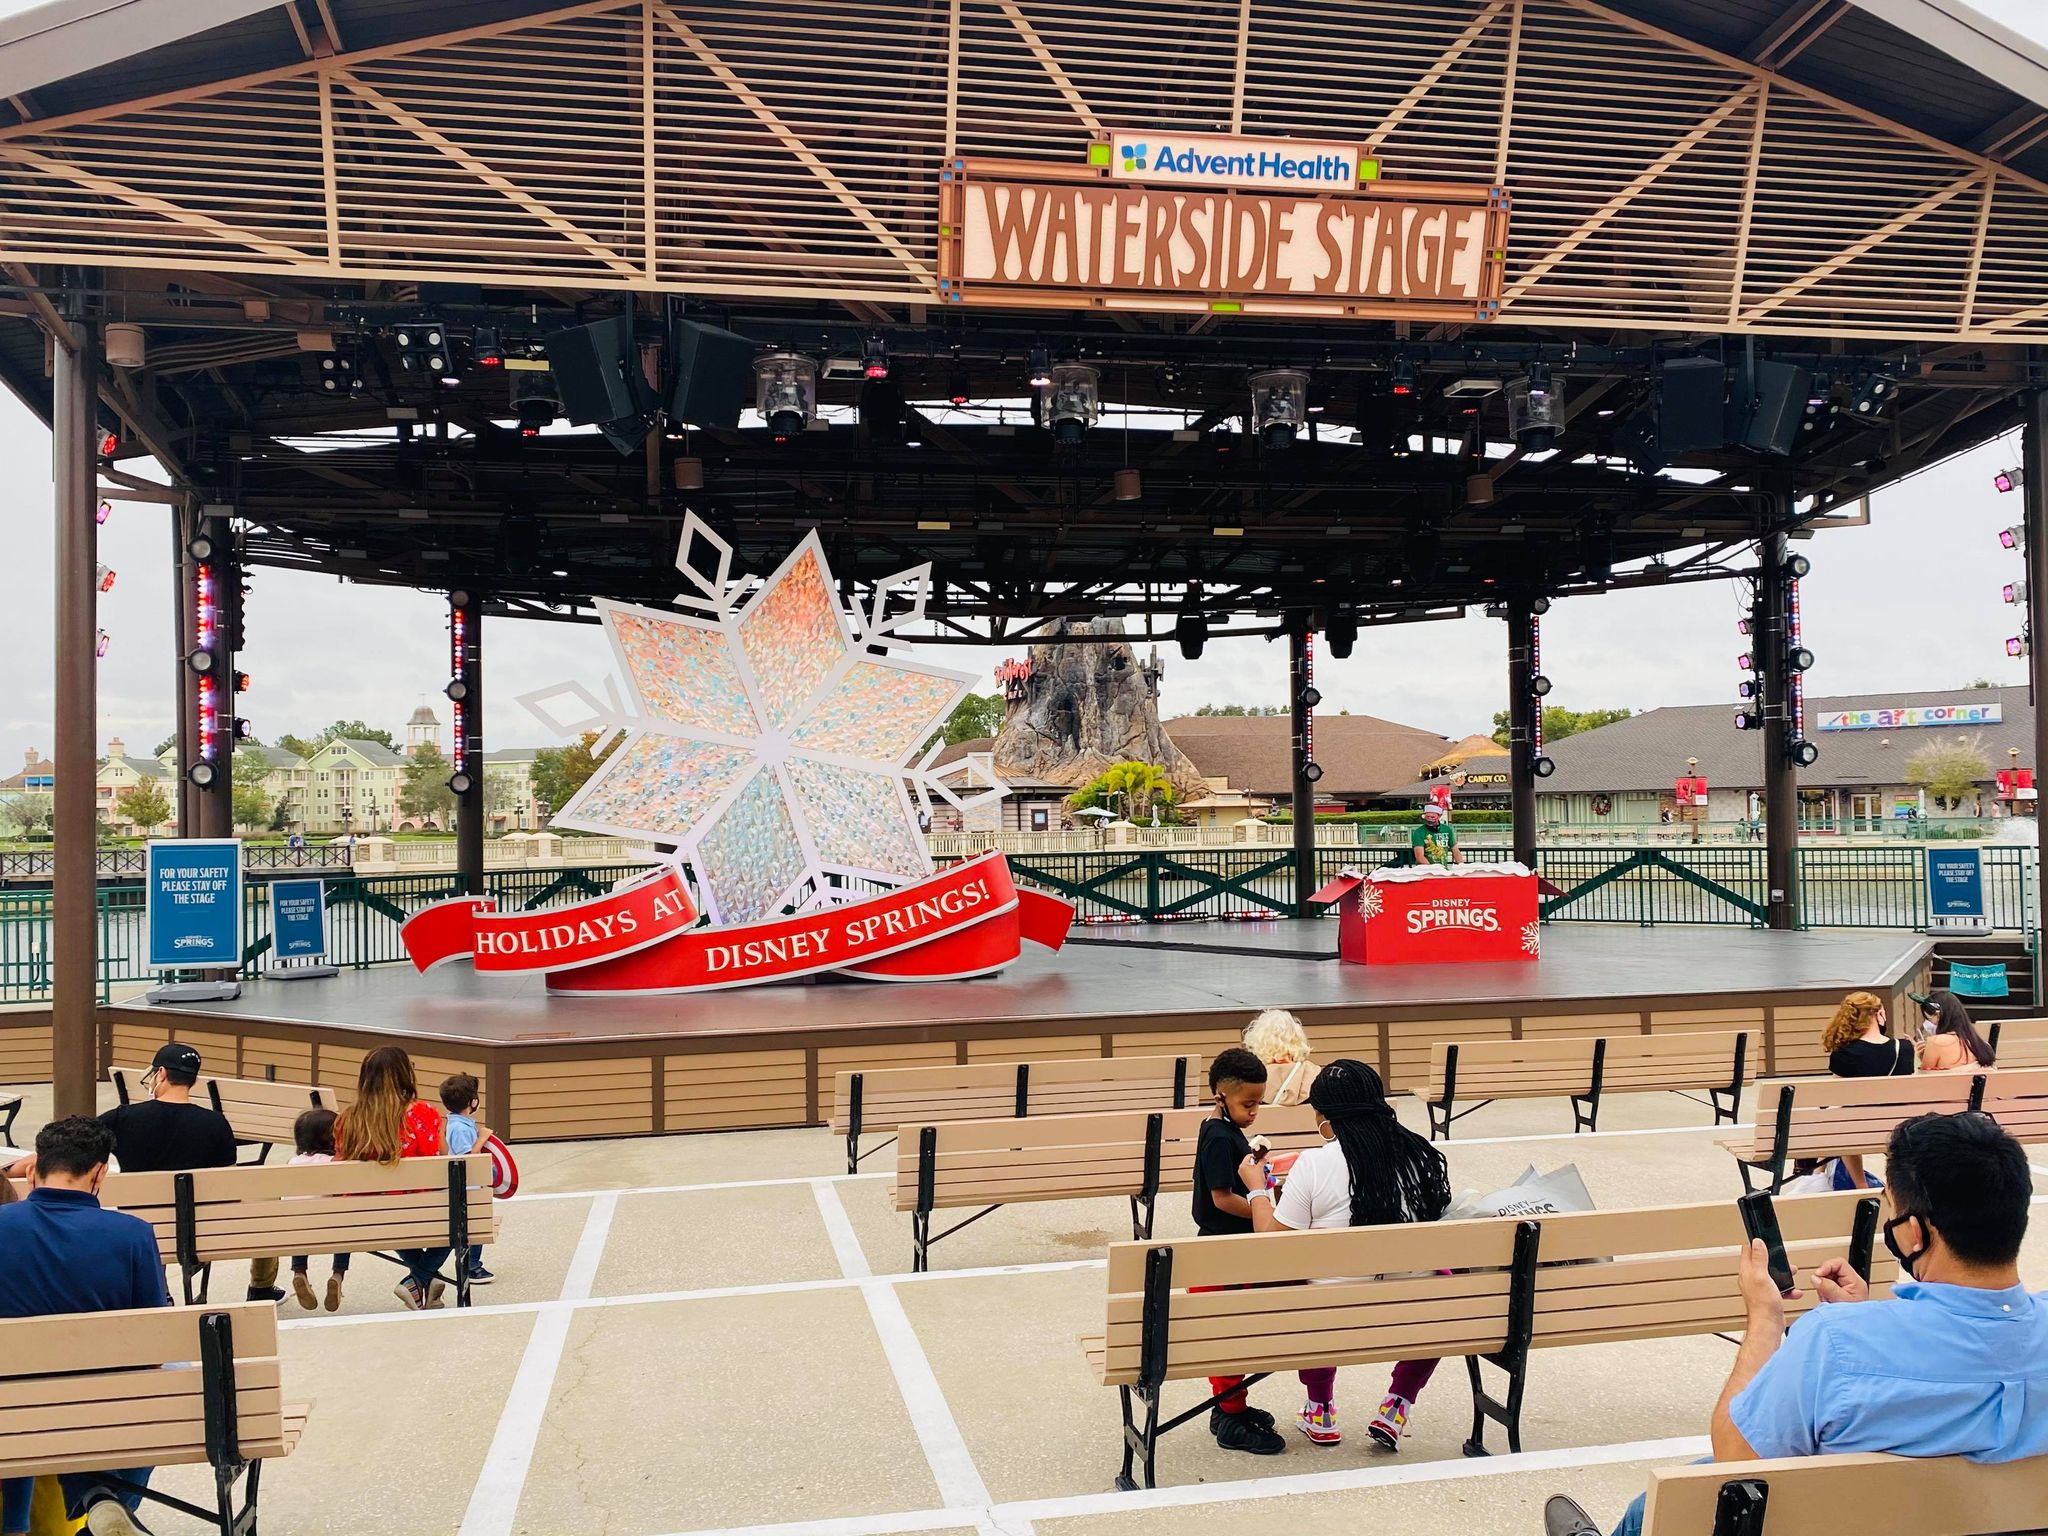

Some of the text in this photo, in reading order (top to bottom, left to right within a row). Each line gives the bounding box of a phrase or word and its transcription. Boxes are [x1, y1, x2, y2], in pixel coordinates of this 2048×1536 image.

[983, 183, 1474, 298] WATERSIDE STAGE
[1842, 705, 1990, 727] the art corner
[1467, 775, 1494, 784] CANDY
[160, 867, 229, 879] FOR YOUR SAFETY
[162, 880, 227, 892] PLEASE STAY OFF
[173, 893, 215, 904] THE STAGE
[1432, 899, 1470, 908] DISNEY
[477, 888, 687, 955] HOLIDAYS AT
[704, 877, 991, 972] DISNEY SPRINGS!
[1406, 908, 1498, 934] SPRINGS
[174, 938, 214, 949] SPRINGS
[1498, 1200, 1530, 1217] DISNEY
